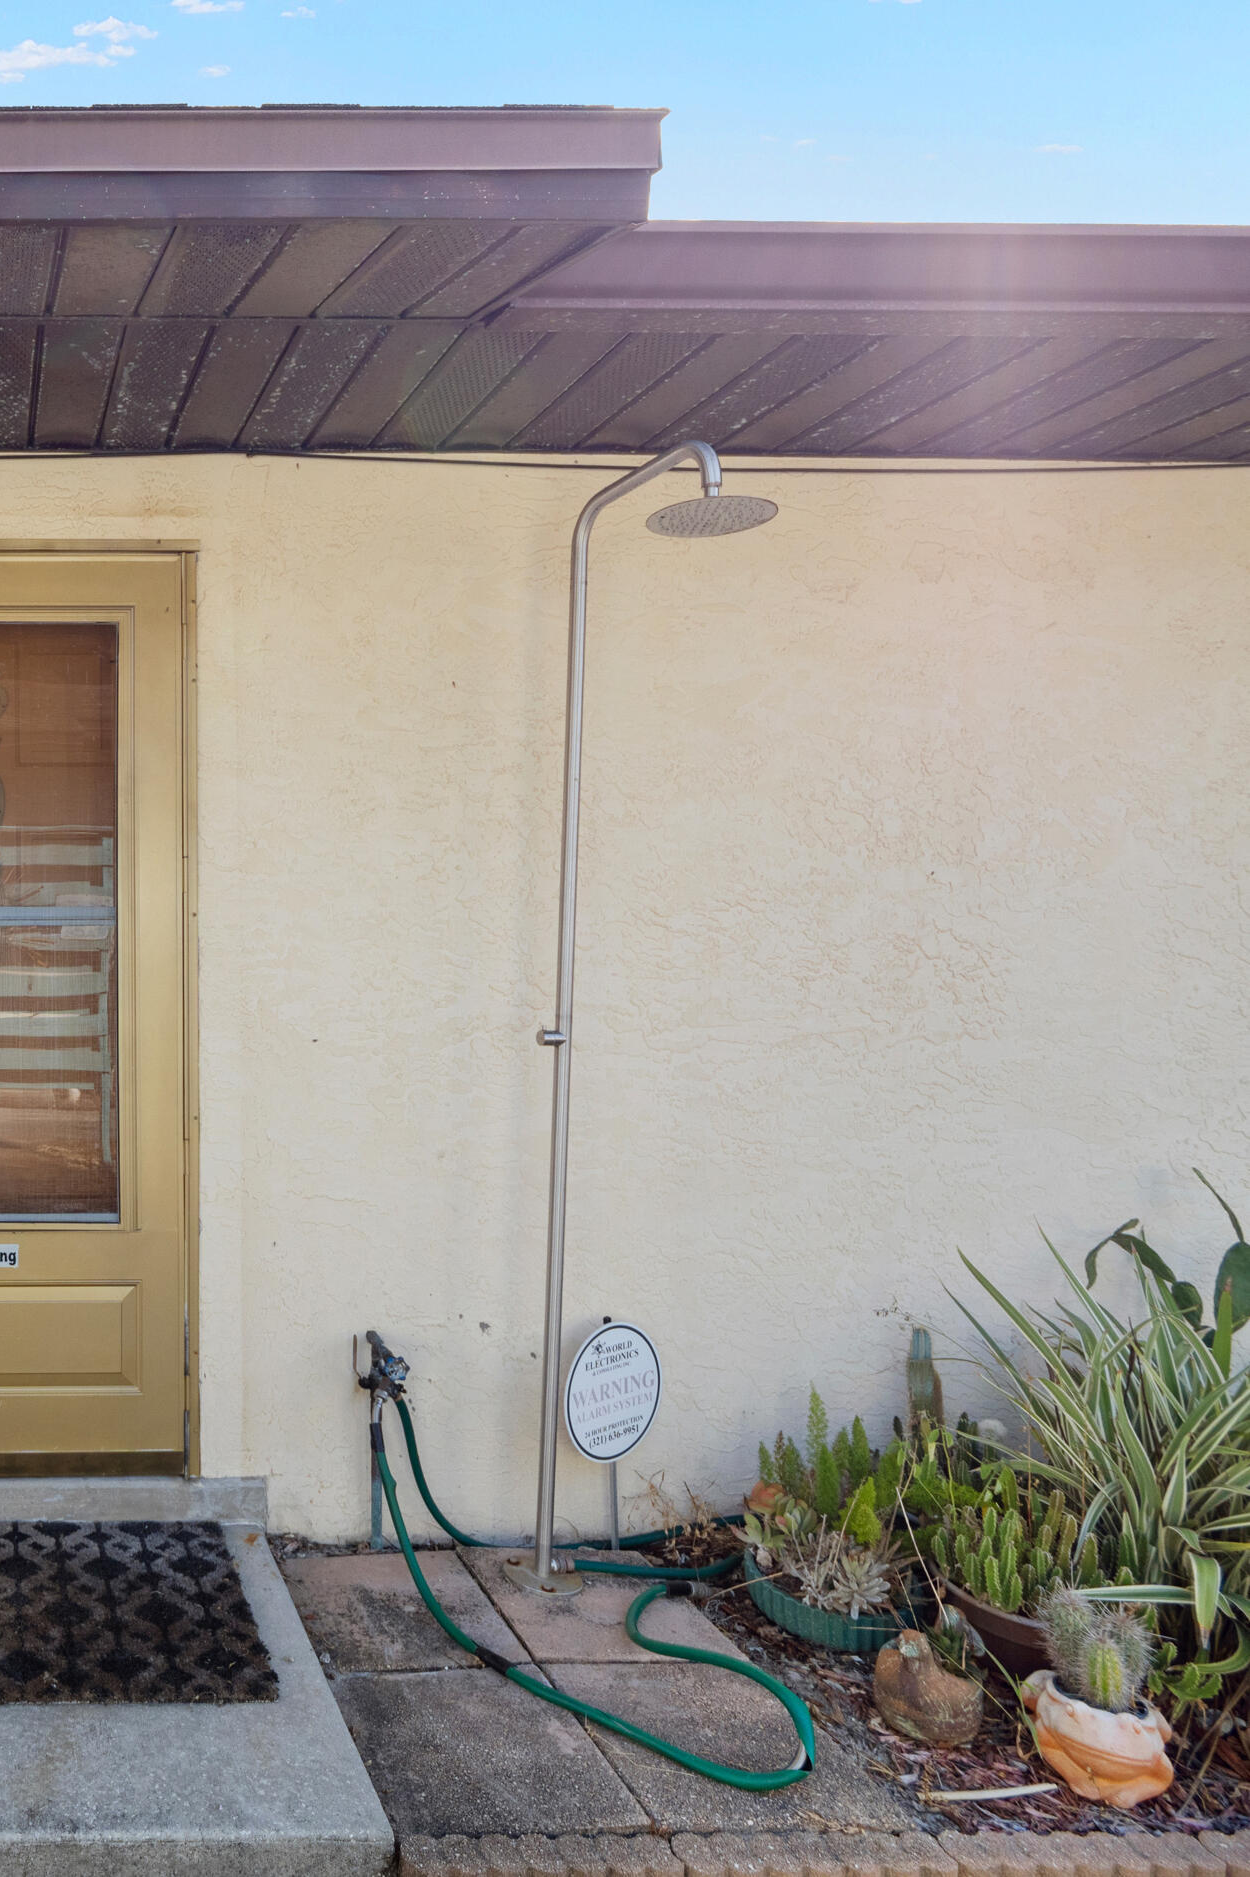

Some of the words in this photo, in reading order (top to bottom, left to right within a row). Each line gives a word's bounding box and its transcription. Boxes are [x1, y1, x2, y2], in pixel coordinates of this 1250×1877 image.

[605, 1340, 633, 1354] WORLD
[585, 1348, 639, 1372] ELECTRONICS
[572, 1370, 655, 1410] WARNING
[575, 1402, 611, 1425] ALARM
[613, 1392, 653, 1414] SYSTEM
[589, 1435, 607, 1449] (321)
[608, 1424, 640, 1442] 636-9951
[591, 1426, 607, 1437] HOUR
[608, 1415, 644, 1431] PROTECTION
